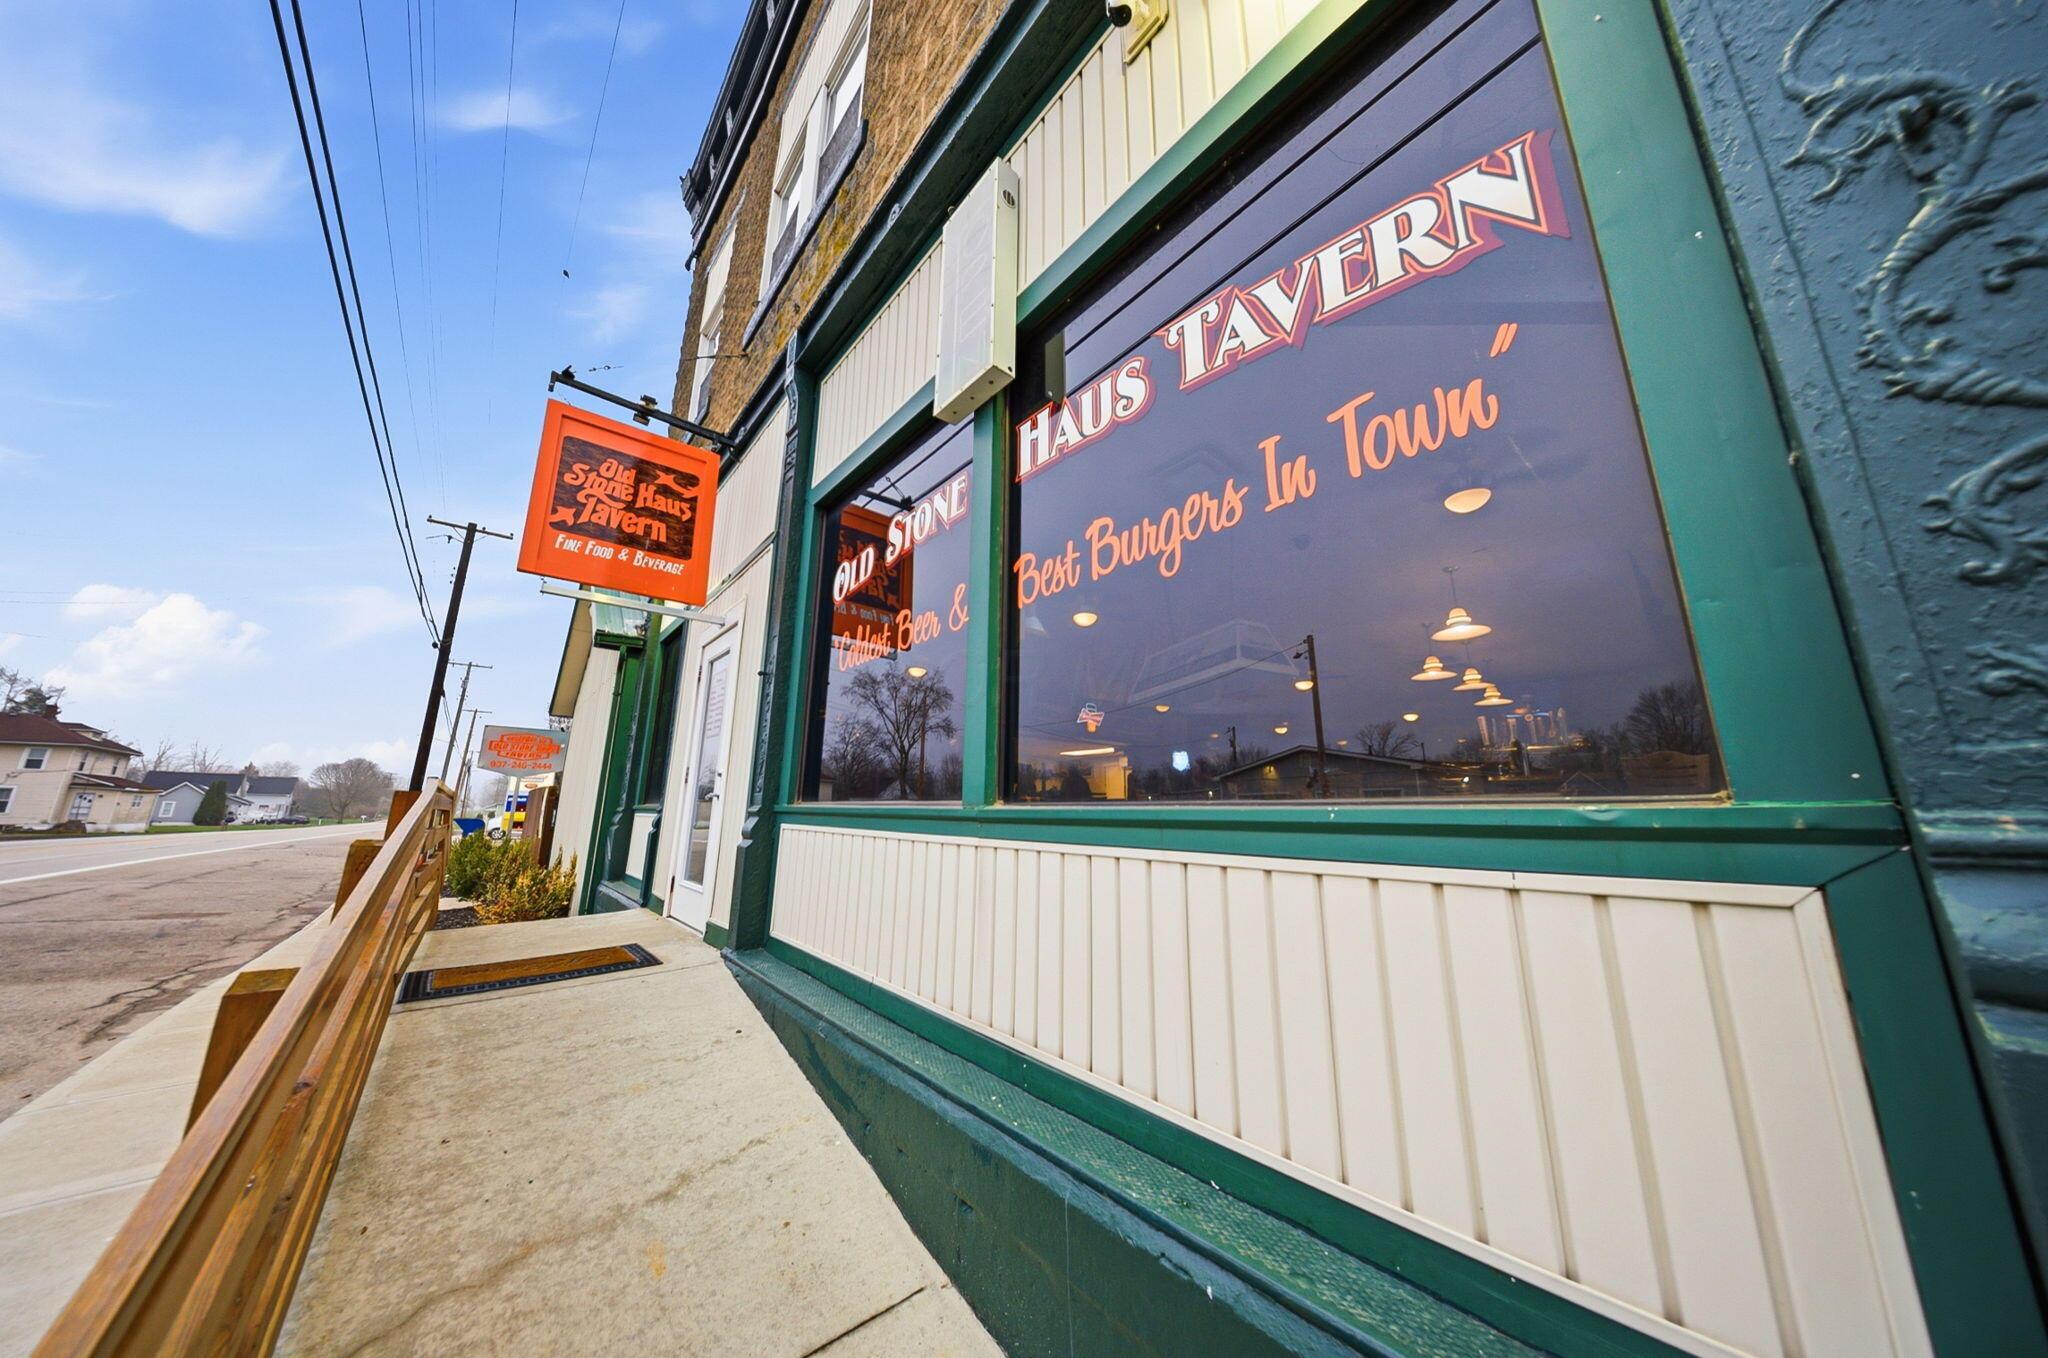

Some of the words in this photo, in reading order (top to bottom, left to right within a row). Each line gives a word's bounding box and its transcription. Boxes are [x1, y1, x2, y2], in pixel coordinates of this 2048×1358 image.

[833, 547, 875, 603] OLD
[885, 471, 969, 566] STONE
[1015, 356, 1153, 483] HAUS
[1158, 130, 1552, 390] TAVERN
[563, 463, 635, 502] Stone
[635, 483, 692, 522] Haus
[599, 458, 635, 486] Old
[577, 488, 667, 543] Tavern
[896, 608, 941, 650] Beer
[949, 583, 969, 632] &
[1013, 540, 1081, 609] Best
[1085, 478, 1249, 578] Burgers
[1258, 434, 1317, 513] In
[585, 540, 615, 560] FOOD
[618, 548, 629, 561] &
[633, 551, 686, 576] BEVERAGE
